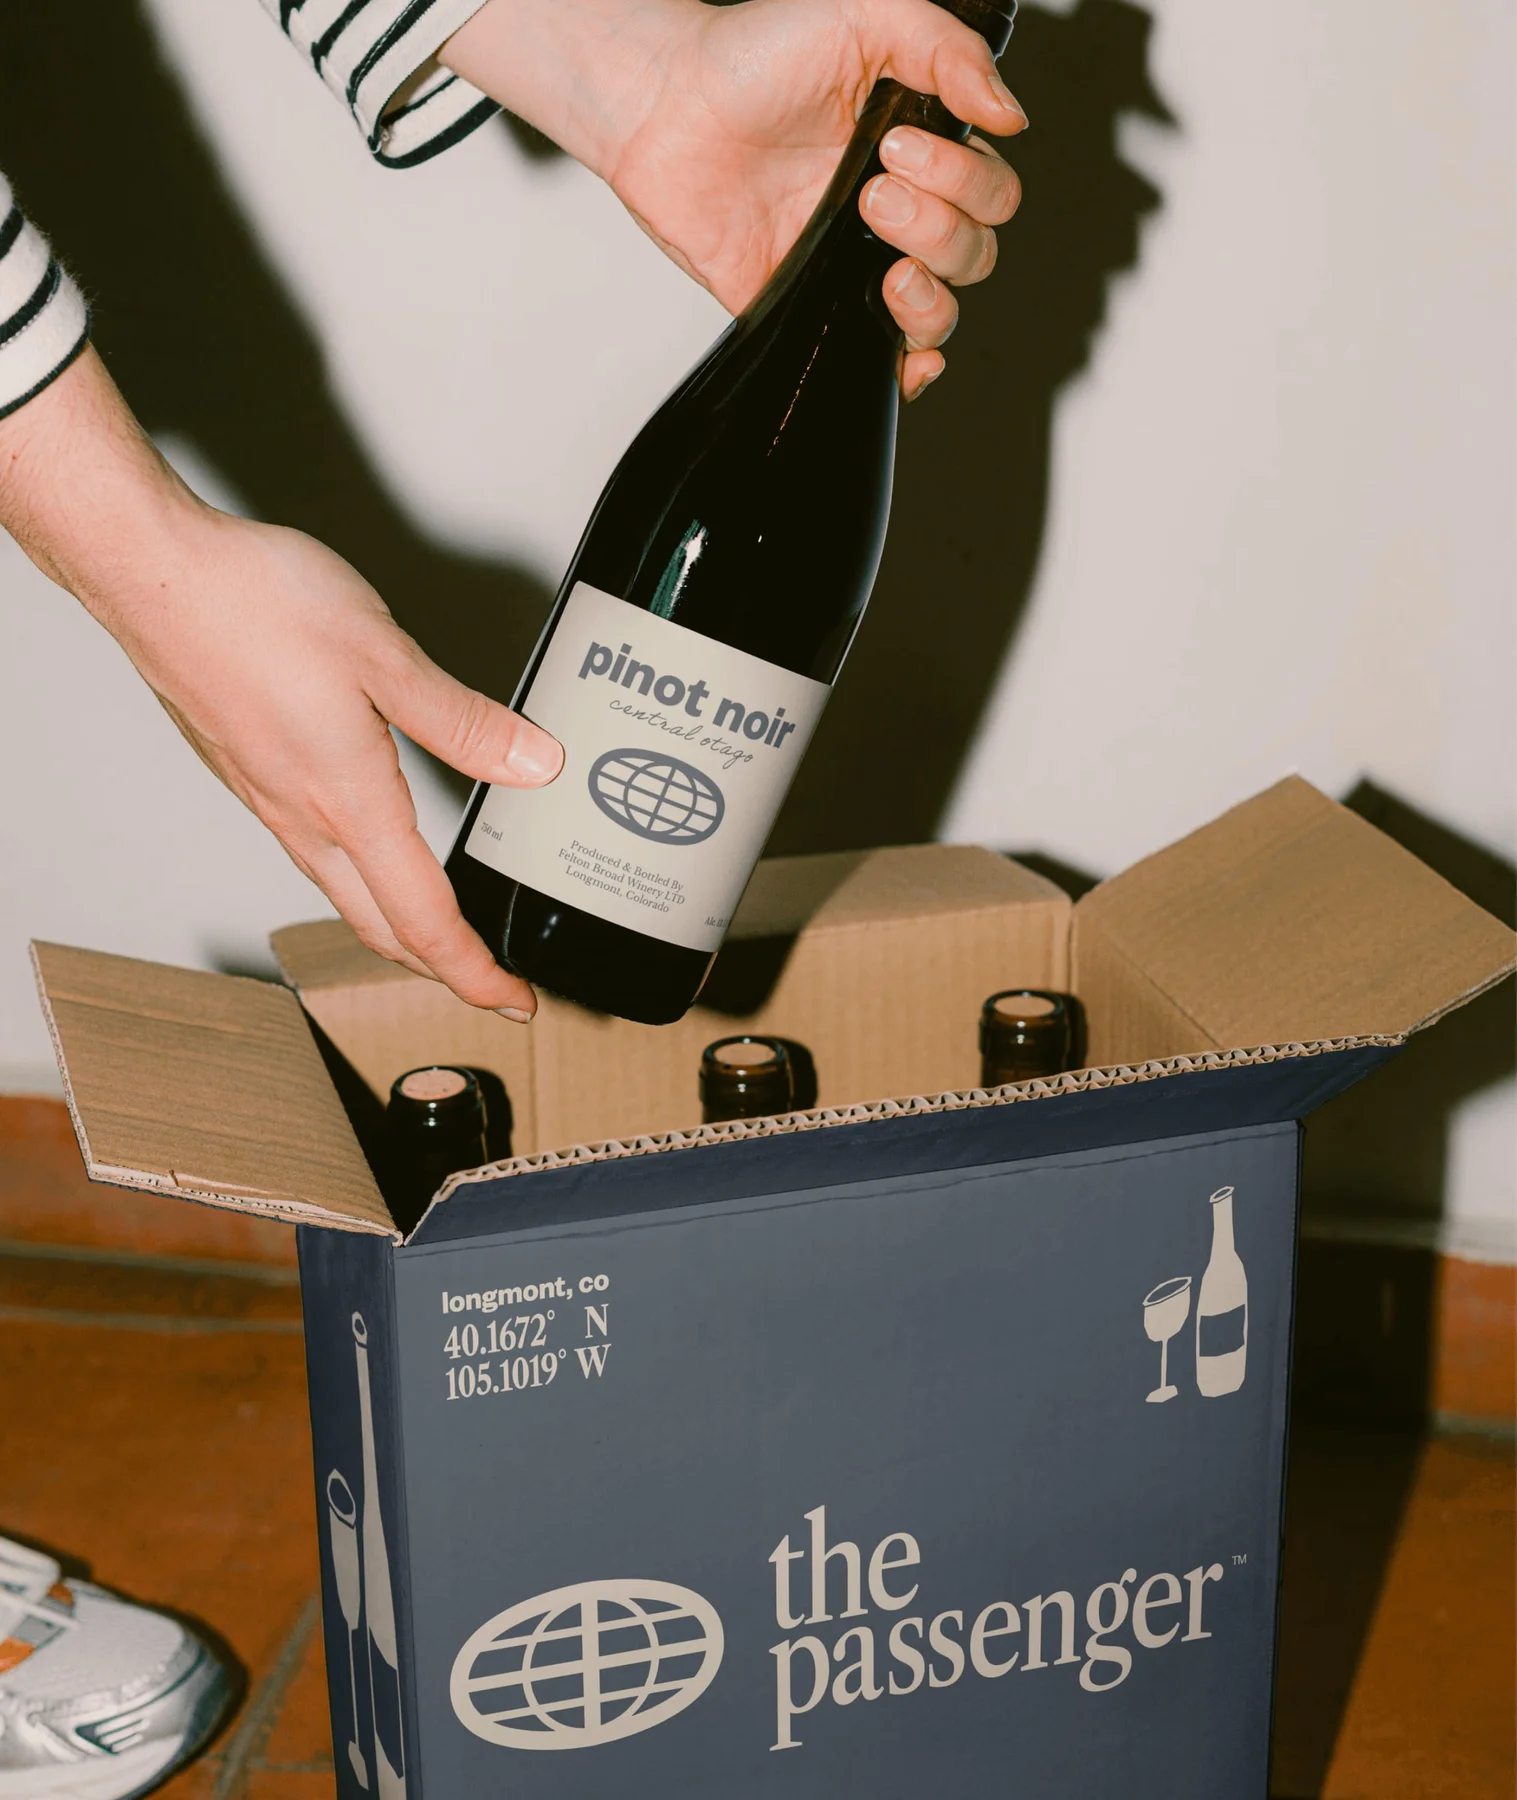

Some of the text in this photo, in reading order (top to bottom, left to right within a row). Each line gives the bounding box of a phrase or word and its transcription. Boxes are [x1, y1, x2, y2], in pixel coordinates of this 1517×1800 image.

[578, 641, 797, 749] pinot noir
[609, 700, 753, 769] central otago
[481, 821, 503, 841] 750 ml
[558, 848, 686, 905] Felton Broad Winery LTD
[565, 865, 670, 913] Longmont, Colorado
[570, 840, 684, 893] Produced & Bottled By
[442, 1274, 610, 1314] longmont, co
[584, 1303, 609, 1338] N
[573, 1343, 612, 1379] W
[768, 1504, 921, 1630] the
[768, 1562, 1224, 1751] passenger
